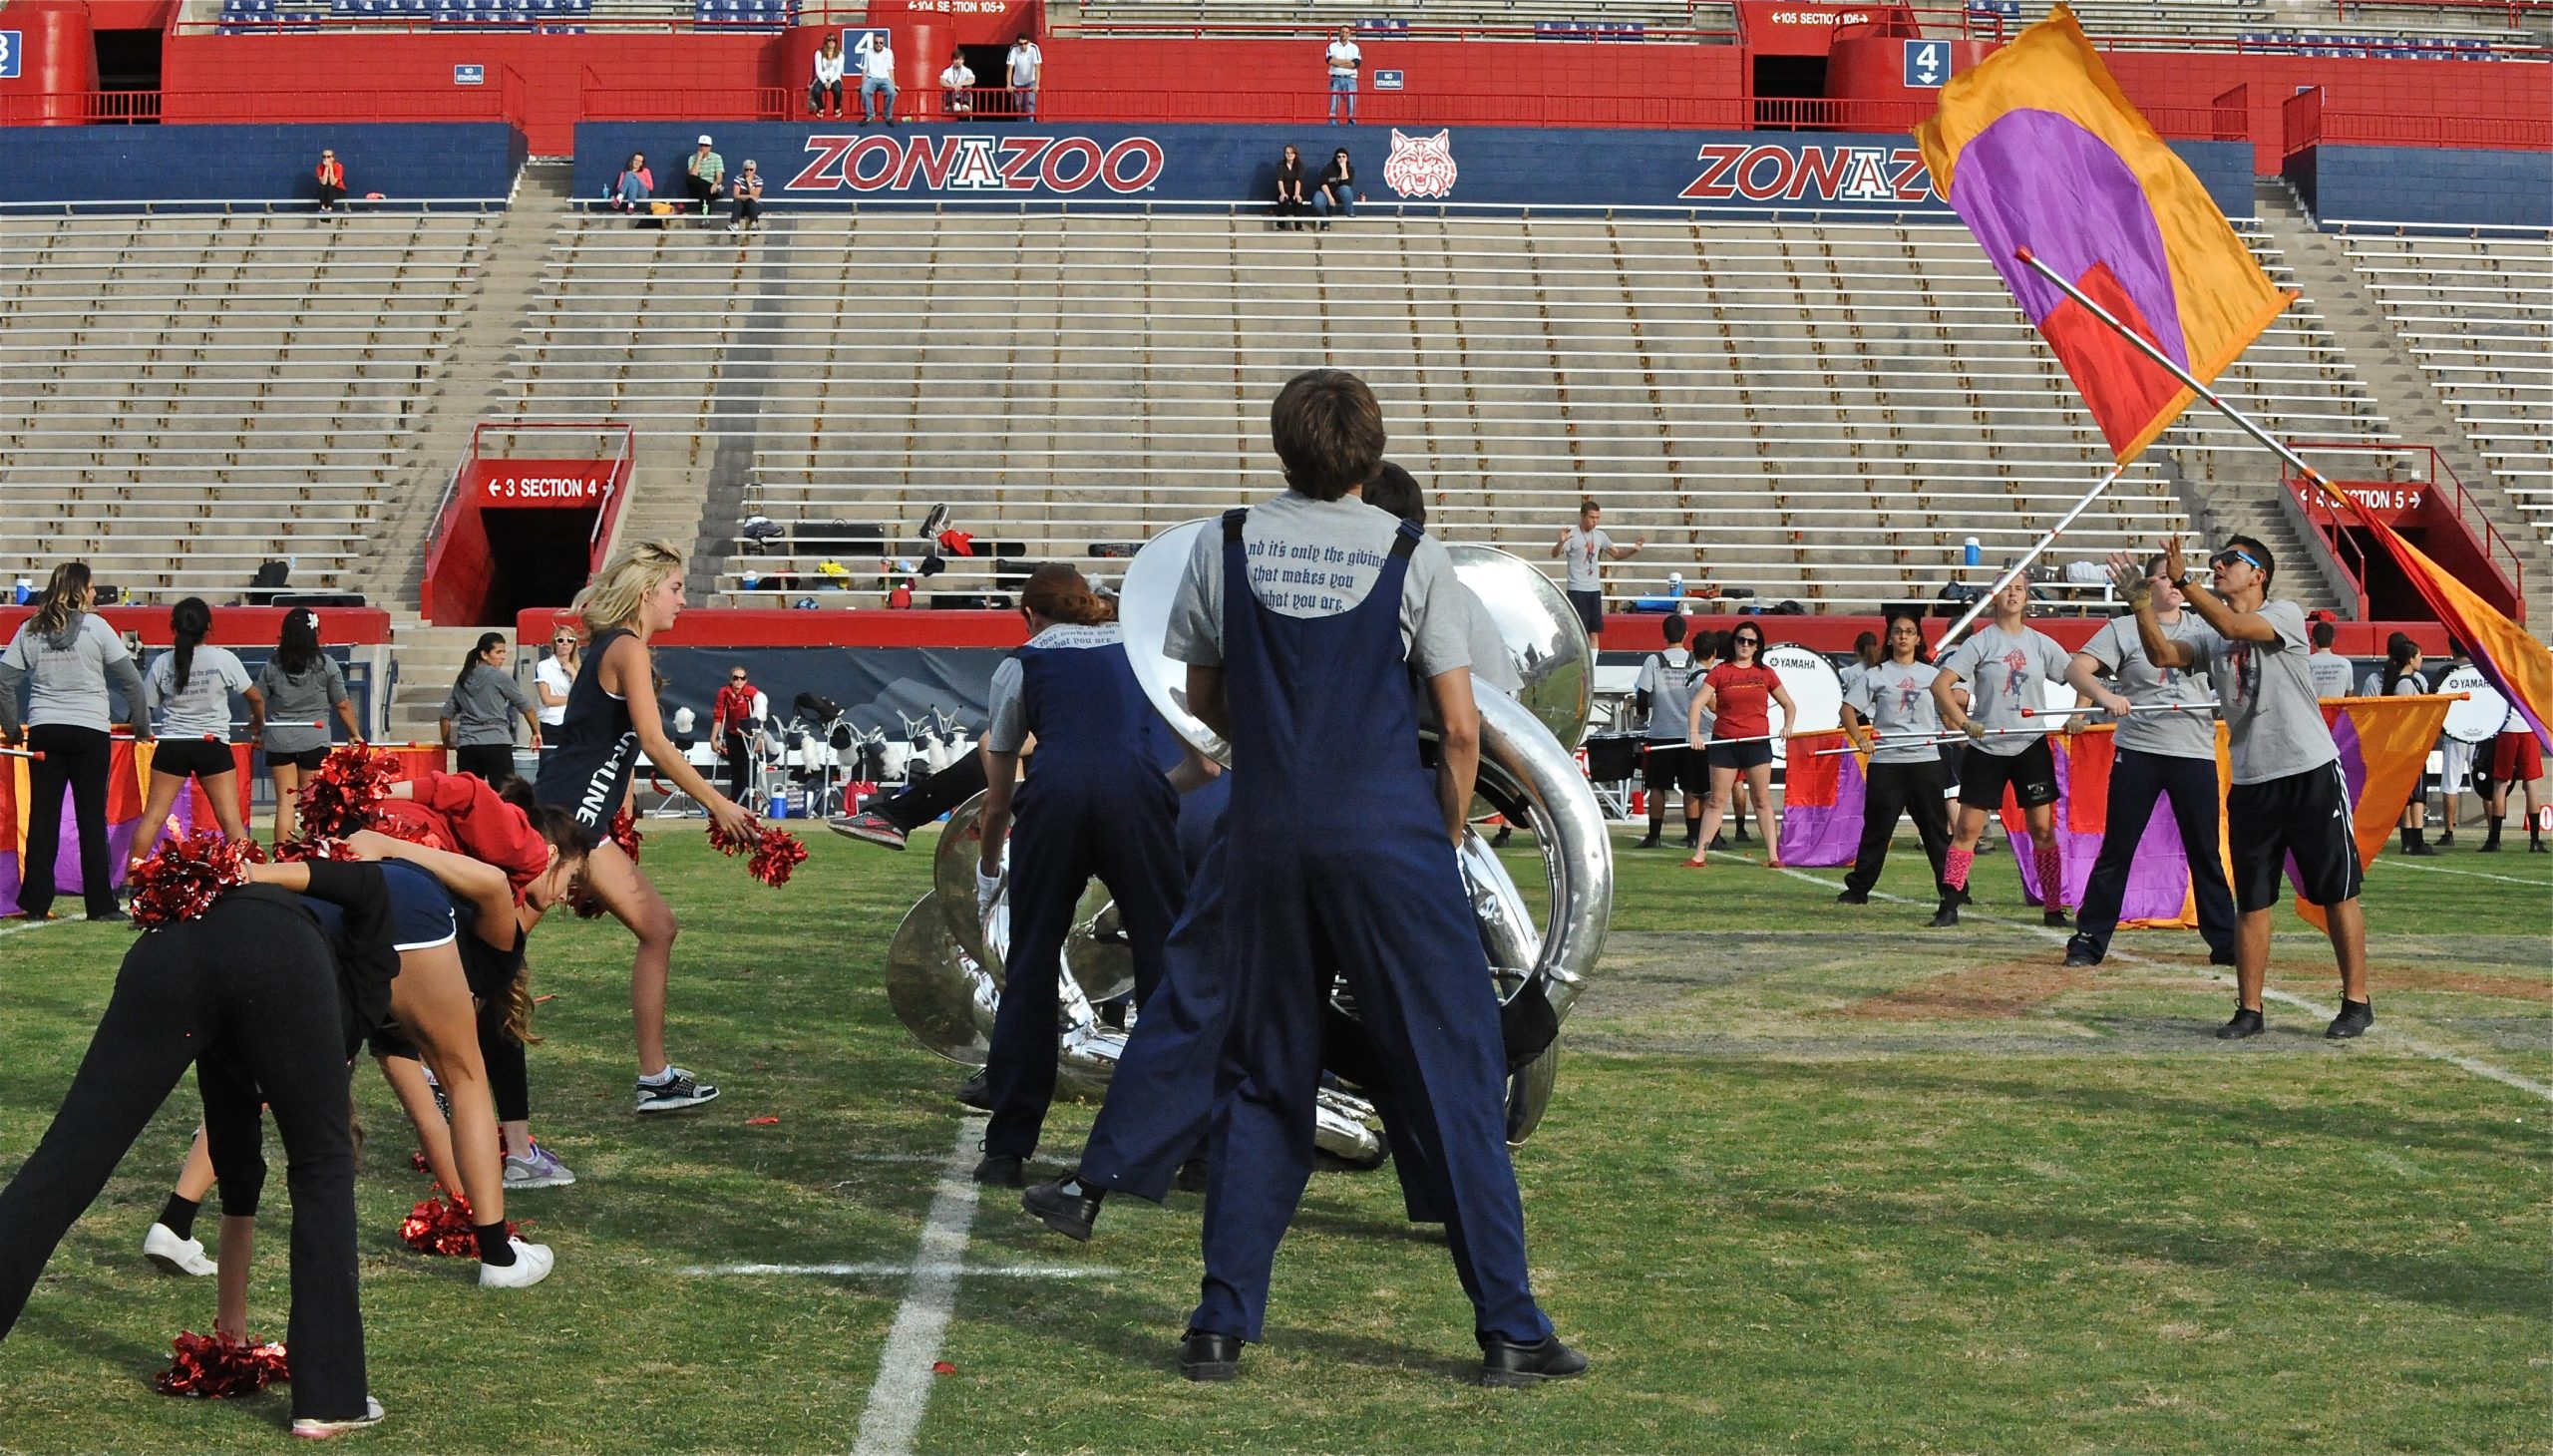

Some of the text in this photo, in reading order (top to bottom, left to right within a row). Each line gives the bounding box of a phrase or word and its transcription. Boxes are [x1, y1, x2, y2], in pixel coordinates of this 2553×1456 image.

[916, 2, 933, 11] 104
[980, 3, 996, 13] 105
[1781, 13, 1797, 24] 105
[1843, 14, 1859, 24] 106
[1916, 44, 1939, 71] 4
[1677, 145, 1949, 203] ZONAZ
[505, 478, 597, 498] 3 SECTION 4
[2394, 491, 2404, 509] 5
[1248, 541, 1265, 556] nd
[1268, 540, 1286, 557] it's
[1290, 545, 1320, 562] only
[1323, 546, 1344, 562] the
[1254, 564, 1354, 588] that makes you
[1292, 594, 1316, 609] you
[1780, 657, 1816, 669] YAMAHA
[2460, 678, 2491, 689] YAMAH
